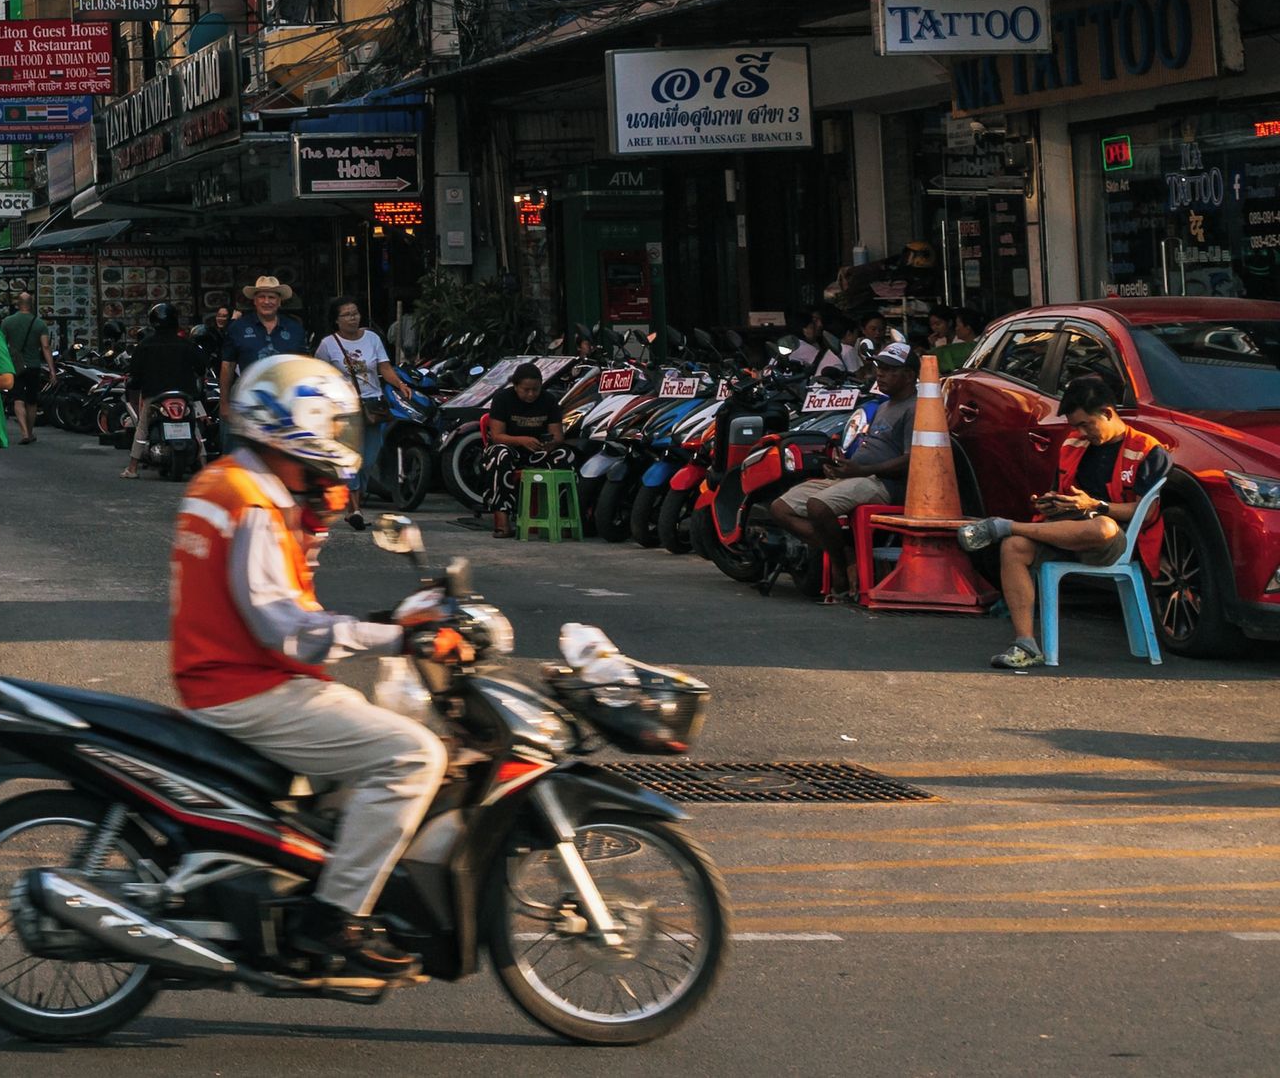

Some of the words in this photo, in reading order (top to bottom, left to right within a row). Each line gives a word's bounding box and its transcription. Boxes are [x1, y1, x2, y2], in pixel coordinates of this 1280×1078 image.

[33, 25, 66, 38] Guest
[71, 24, 108, 37] House
[887, 5, 1041, 44] TATTOO
[14, 40, 24, 52] &
[29, 39, 92, 52] Restaurant
[20, 54, 43, 66] FOOD
[46, 54, 53, 65] &
[55, 53, 84, 65] INDIAN
[87, 52, 110, 64] FOOD
[22, 69, 47, 79] HALAL
[66, 68, 88, 78] FOOD
[105, 99, 129, 150] TASTE
[131, 91, 143, 137] OF
[144, 75, 173, 130] INDIA
[788, 106, 800, 123] 3
[626, 136, 654, 147] AREE
[656, 135, 696, 146] HEALTH
[699, 133, 747, 144] MASSAGE
[751, 132, 792, 143] BRANCH
[796, 131, 803, 141] 3
[300, 146, 324, 159] The
[325, 146, 349, 158] Red
[337, 159, 381, 178] Hotel
[608, 171, 644, 186] ATM
[1120, 280, 1148, 297] needle
[600, 375, 612, 390] For
[613, 373, 630, 388] Rent
[661, 381, 676, 395] For
[676, 379, 695, 395] Rent
[805, 395, 825, 409] For
[826, 394, 854, 408] Rent
